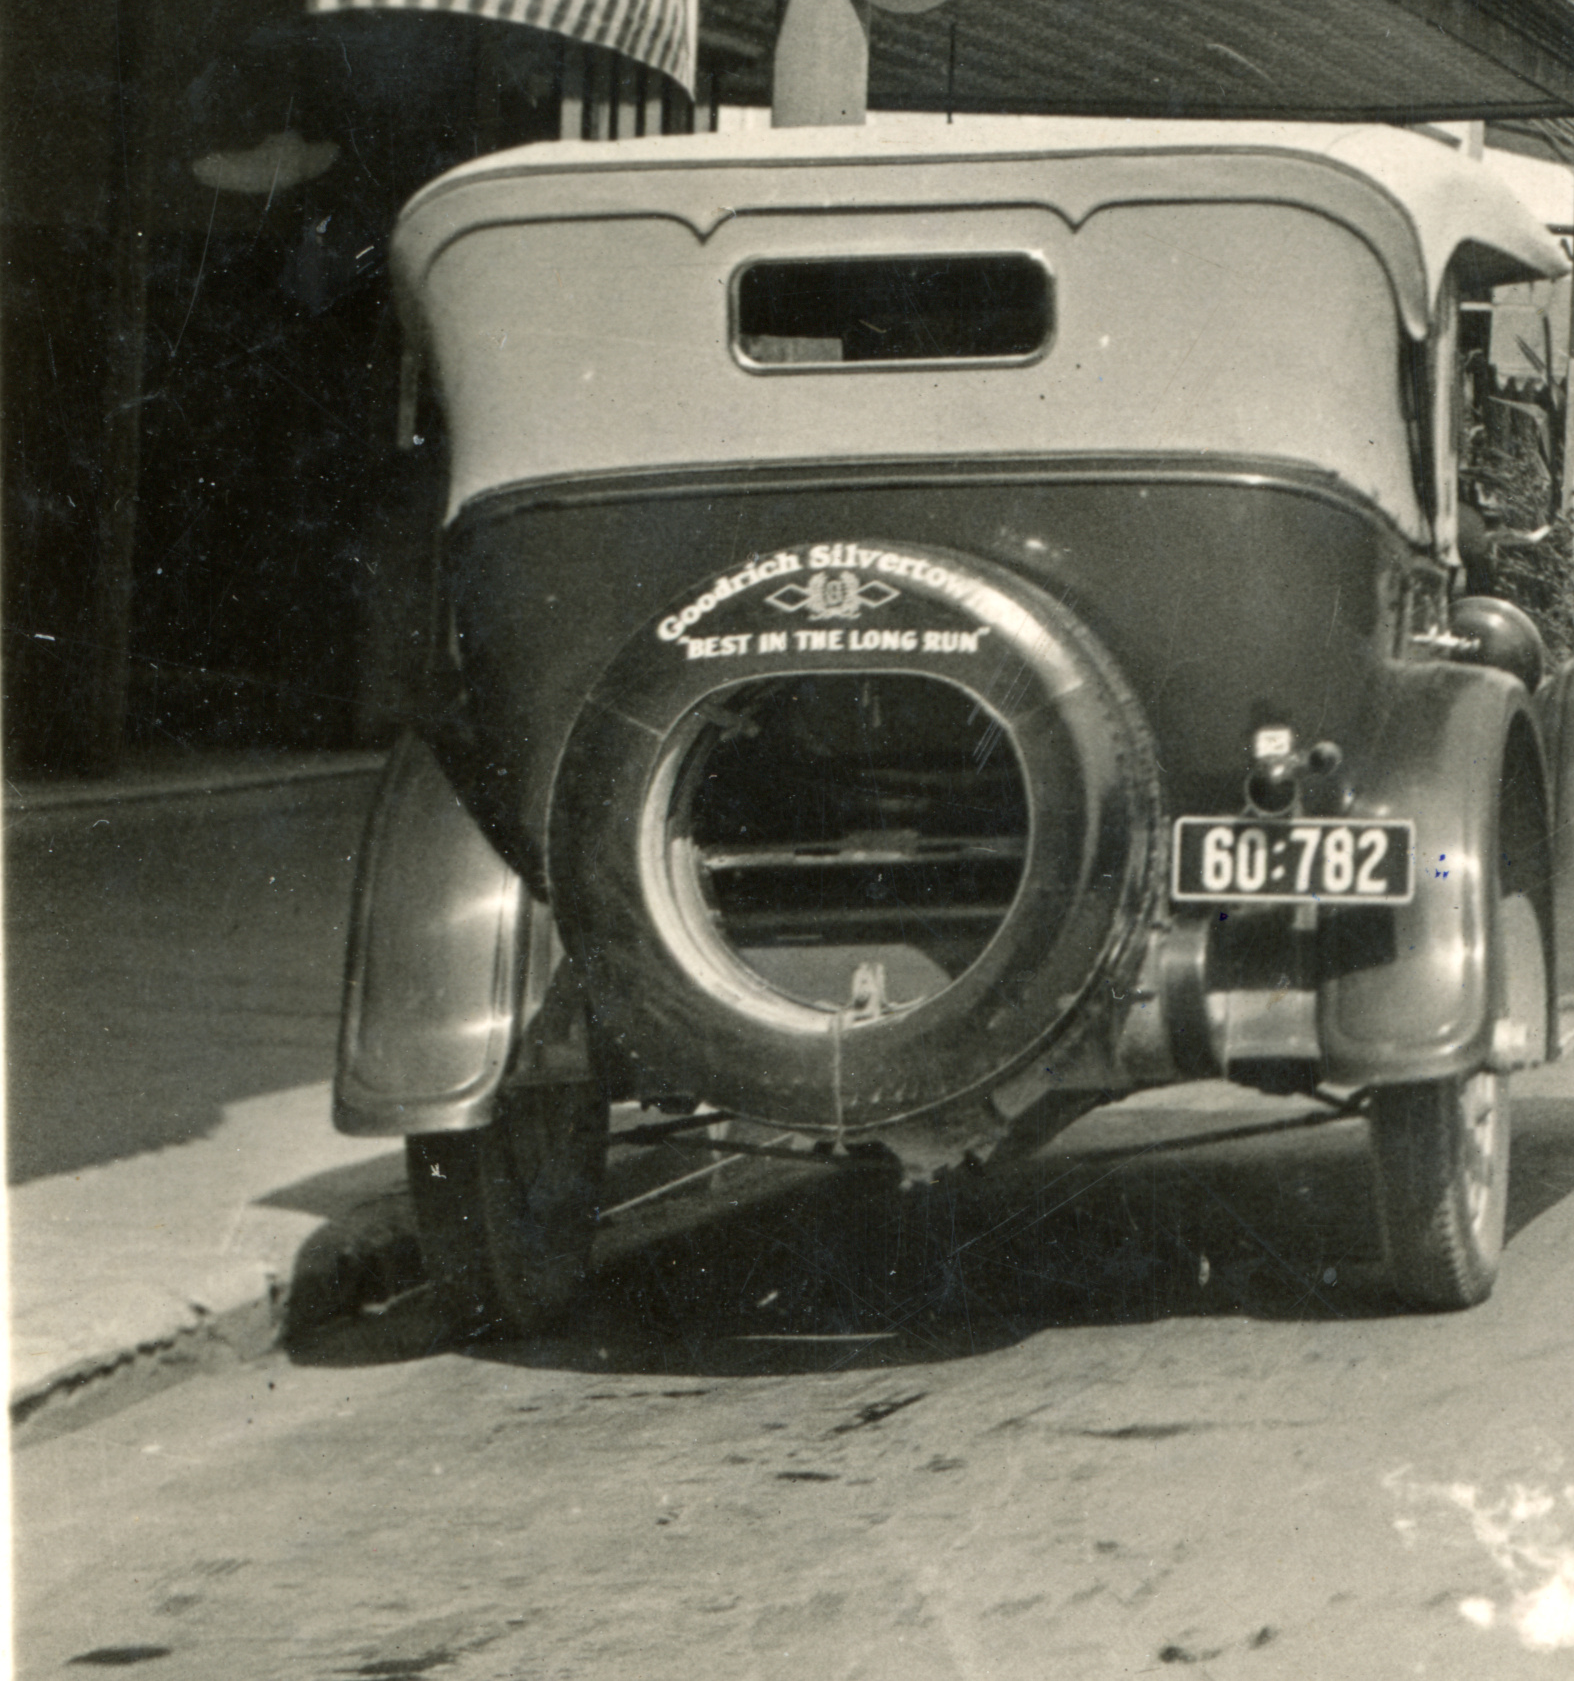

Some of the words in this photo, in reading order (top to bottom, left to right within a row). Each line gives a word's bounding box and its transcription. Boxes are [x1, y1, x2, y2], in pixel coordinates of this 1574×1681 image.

[656, 552, 804, 642] Goodrich
[809, 543, 992, 617] Silvertow
[758, 631, 788, 654] IN
[793, 629, 845, 652] THE
[849, 629, 919, 652] LONG
[1201, 826, 1390, 894] 60:782
